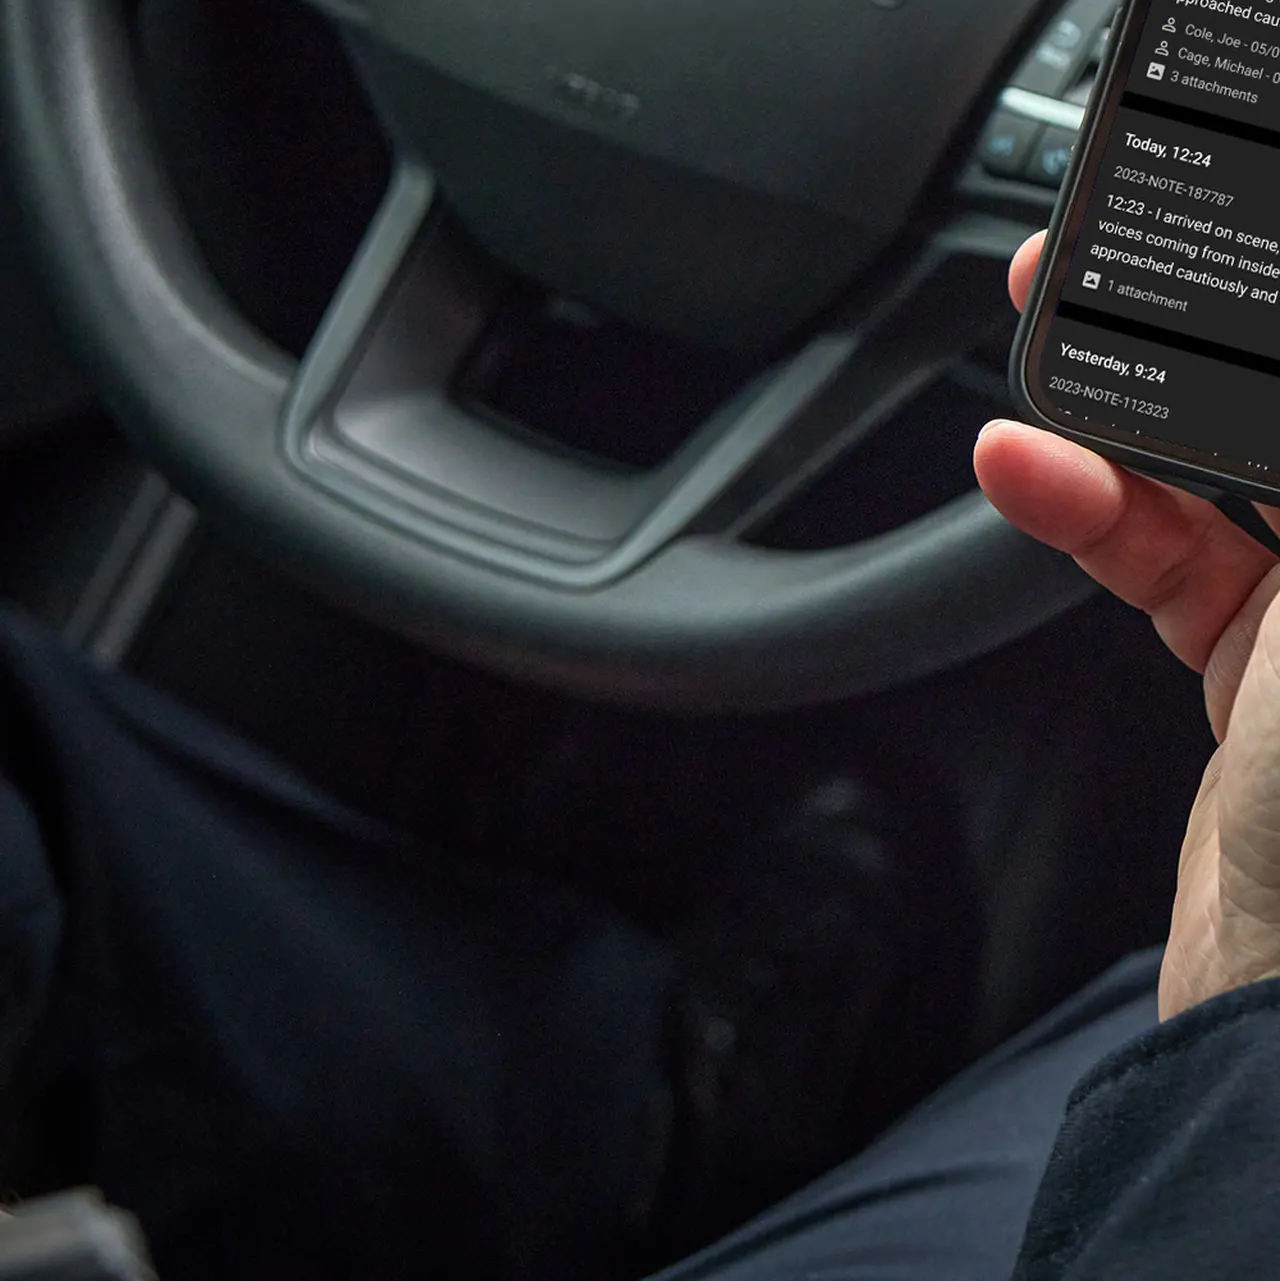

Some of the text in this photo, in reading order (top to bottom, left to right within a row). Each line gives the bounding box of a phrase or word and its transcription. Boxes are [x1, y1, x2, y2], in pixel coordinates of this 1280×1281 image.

[1184, 23, 1214, 43] Cole,
[1216, 33, 1242, 49] Joe
[1177, 47, 1211, 68] Cage,
[1214, 56, 1264, 80] Michael
[1170, 70, 1258, 104] 3 attachments
[1126, 132, 1212, 168] Today, 12:24
[1113, 165, 1235, 207] 2023-NOTE-187787
[1108, 279, 1188, 312] 1 attachment
[1061, 342, 1166, 384] Yesterday, 9:24
[1048, 376, 1170, 420] 2023-NOTE-112323
